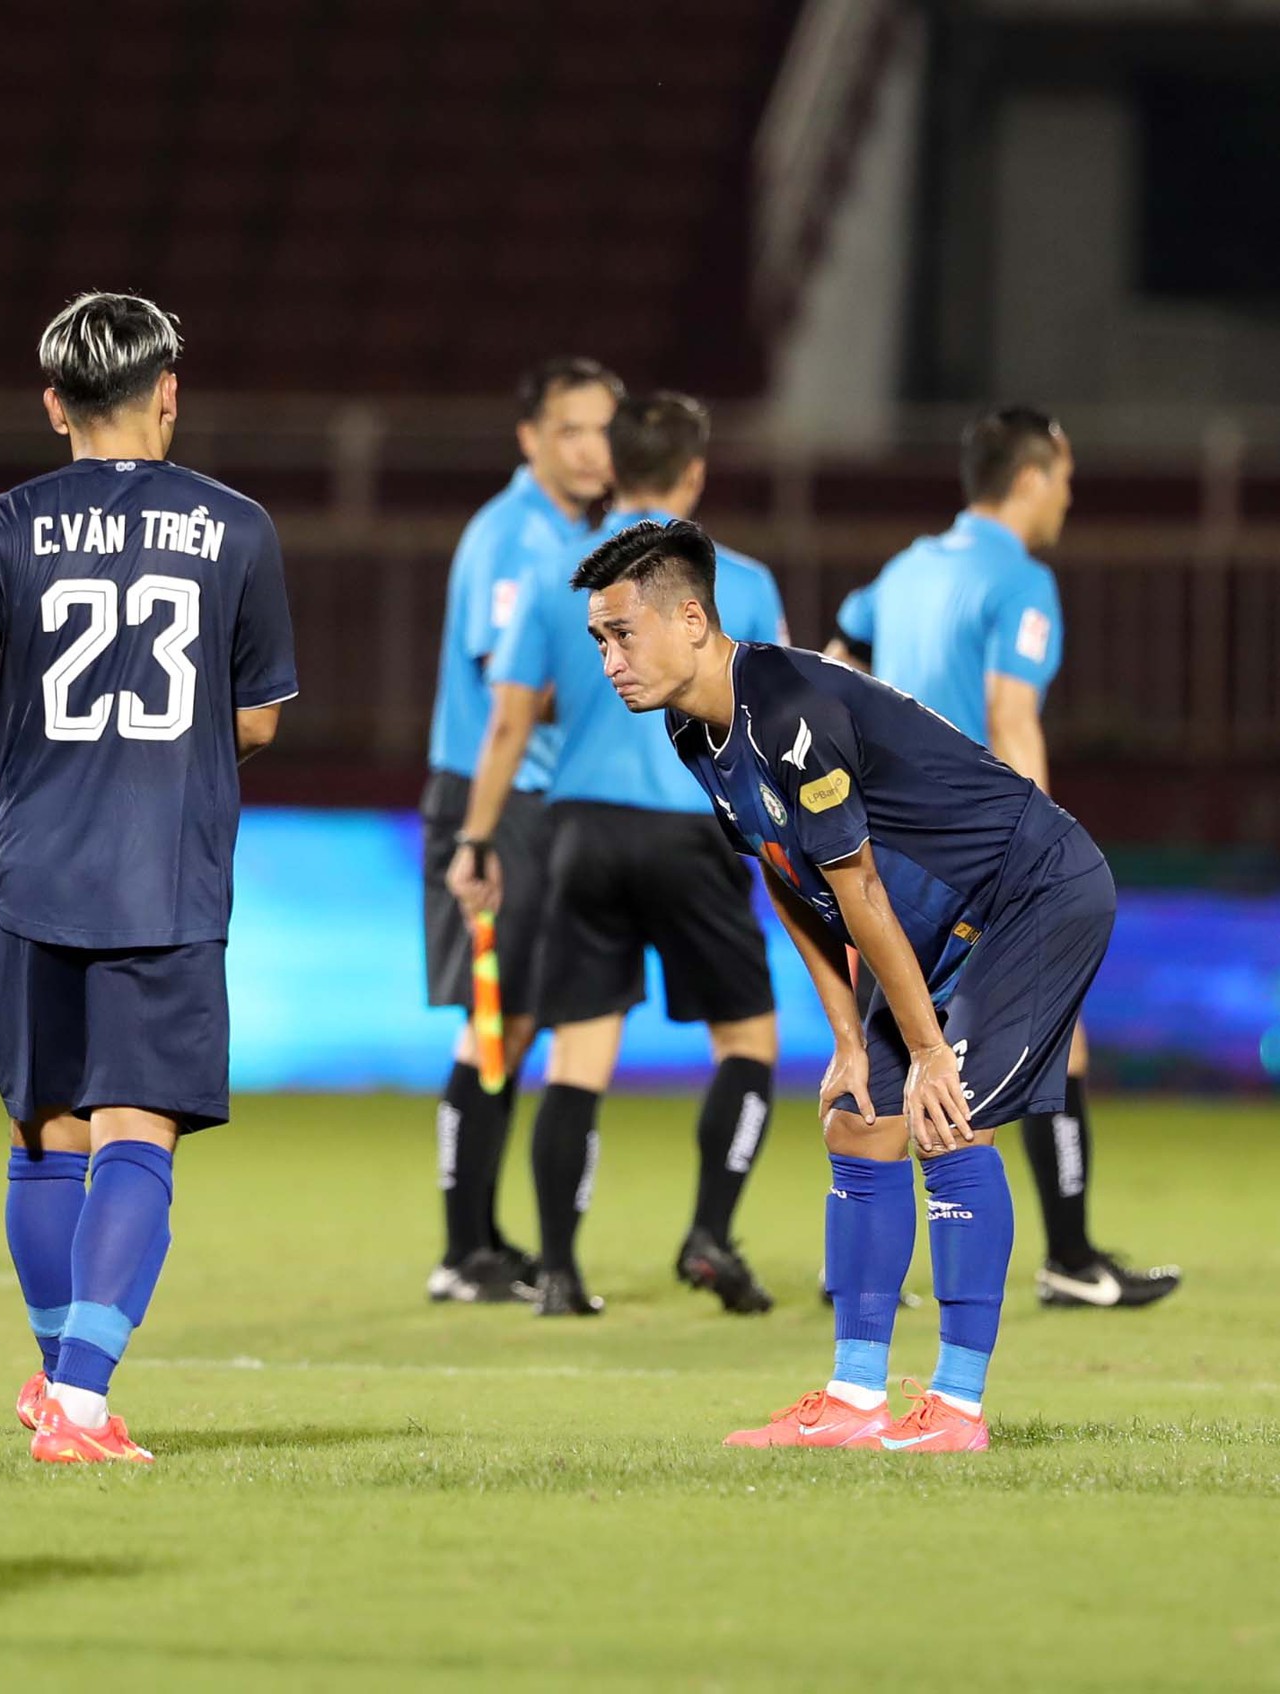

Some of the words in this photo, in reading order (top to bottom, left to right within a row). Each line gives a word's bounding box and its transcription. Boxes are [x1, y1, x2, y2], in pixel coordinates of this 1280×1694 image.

[33, 507, 126, 556] C.VĂN
[141, 505, 226, 562] TRIỀN
[40, 573, 202, 742] 23
